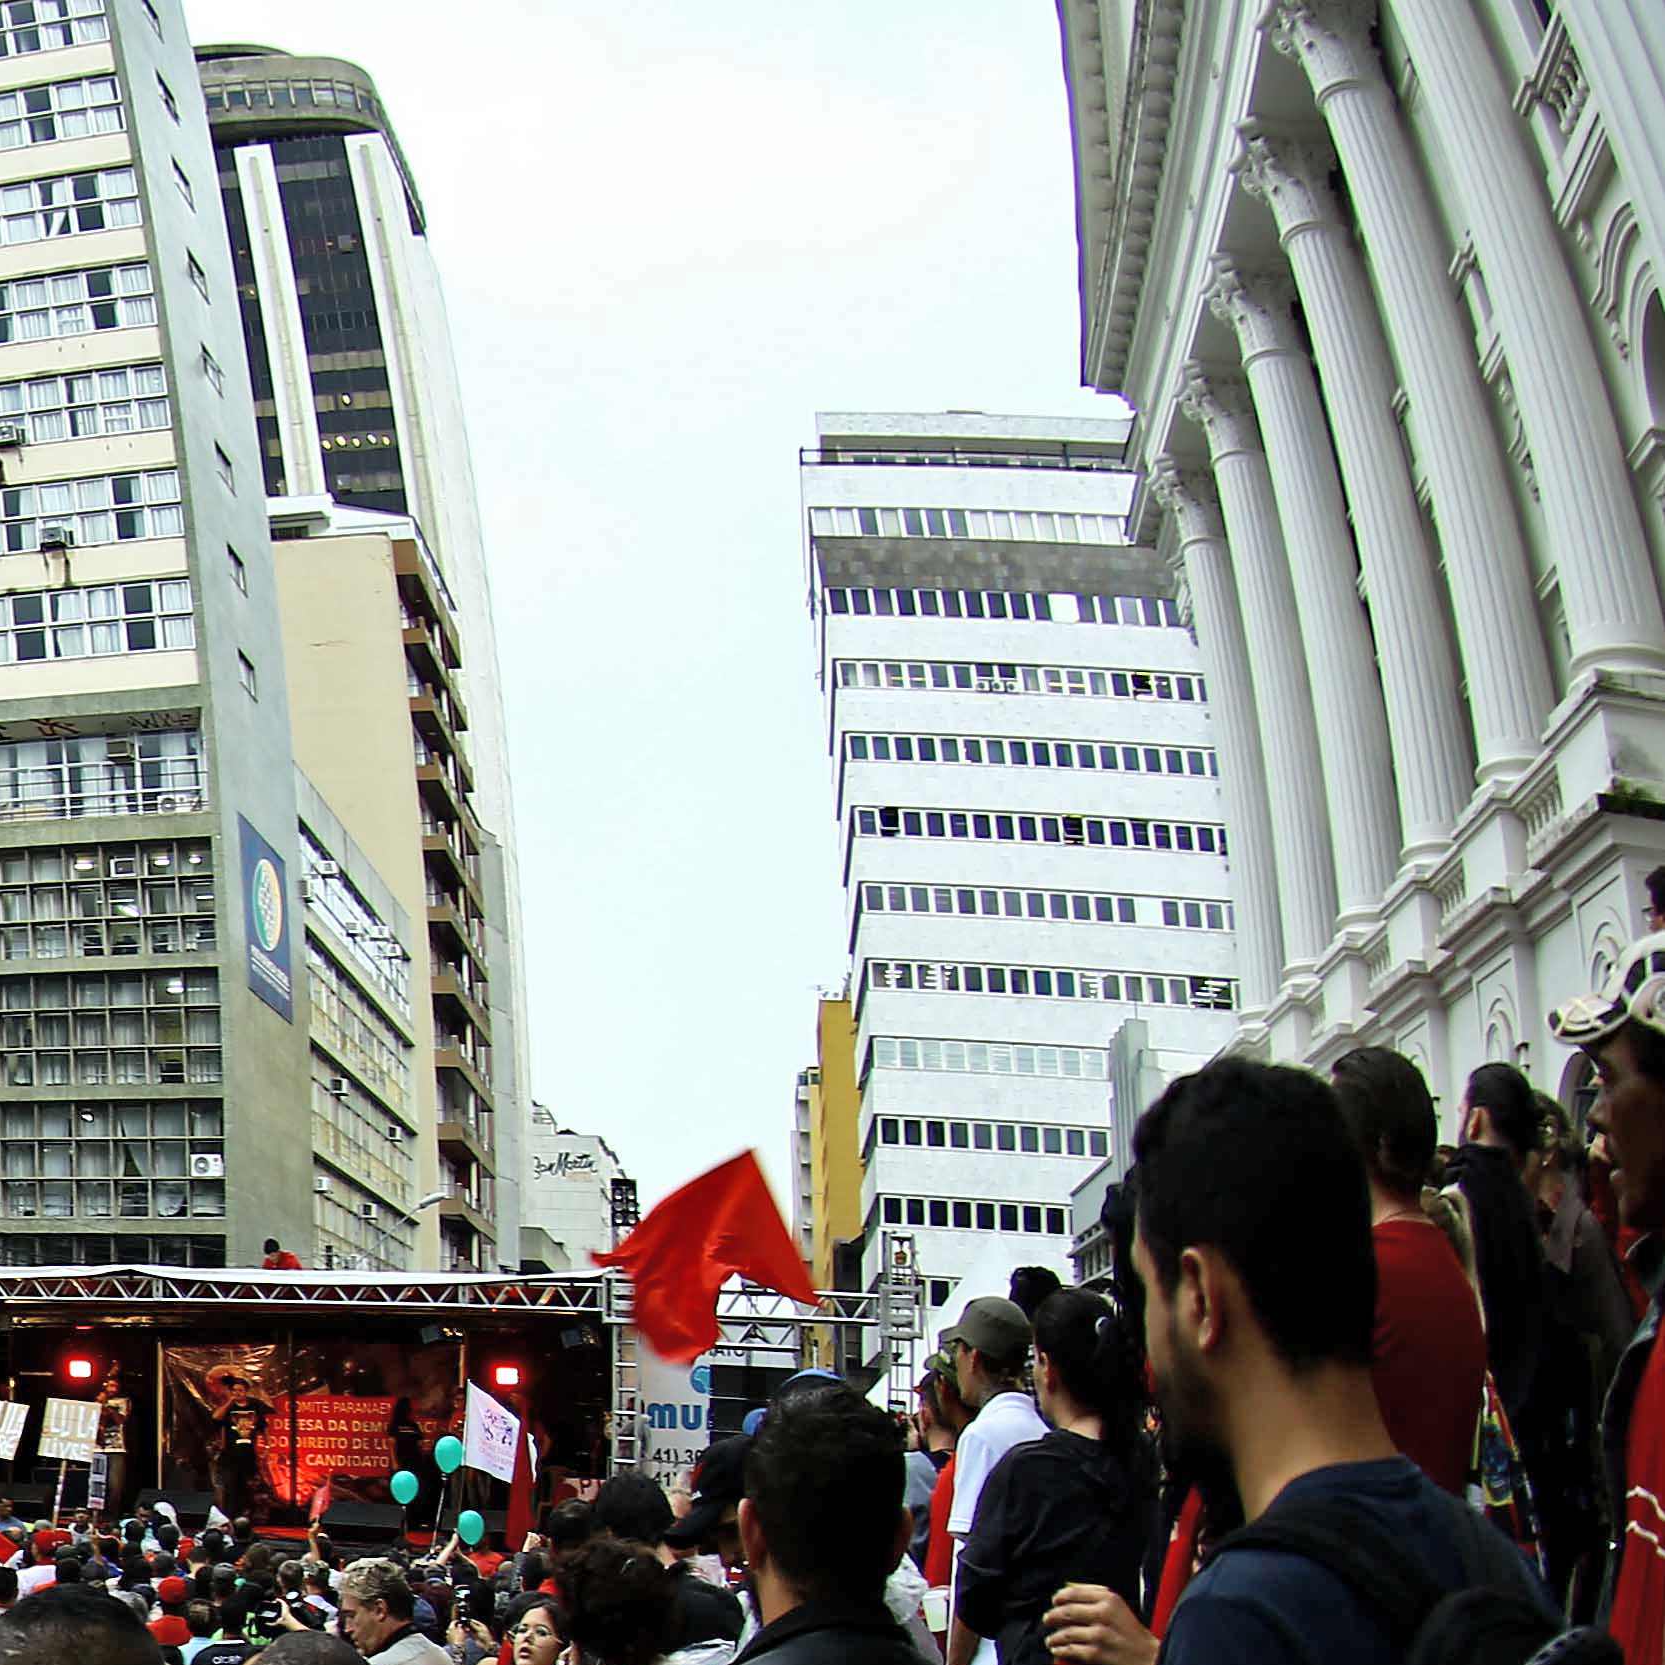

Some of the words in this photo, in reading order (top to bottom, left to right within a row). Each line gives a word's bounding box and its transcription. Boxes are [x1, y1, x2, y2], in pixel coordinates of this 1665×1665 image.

[645, 1402, 711, 1431] mu
[273, 1418, 325, 1432] DEESA
[328, 1419, 349, 1432] DA
[306, 1453, 391, 1468] CANDIDATO
